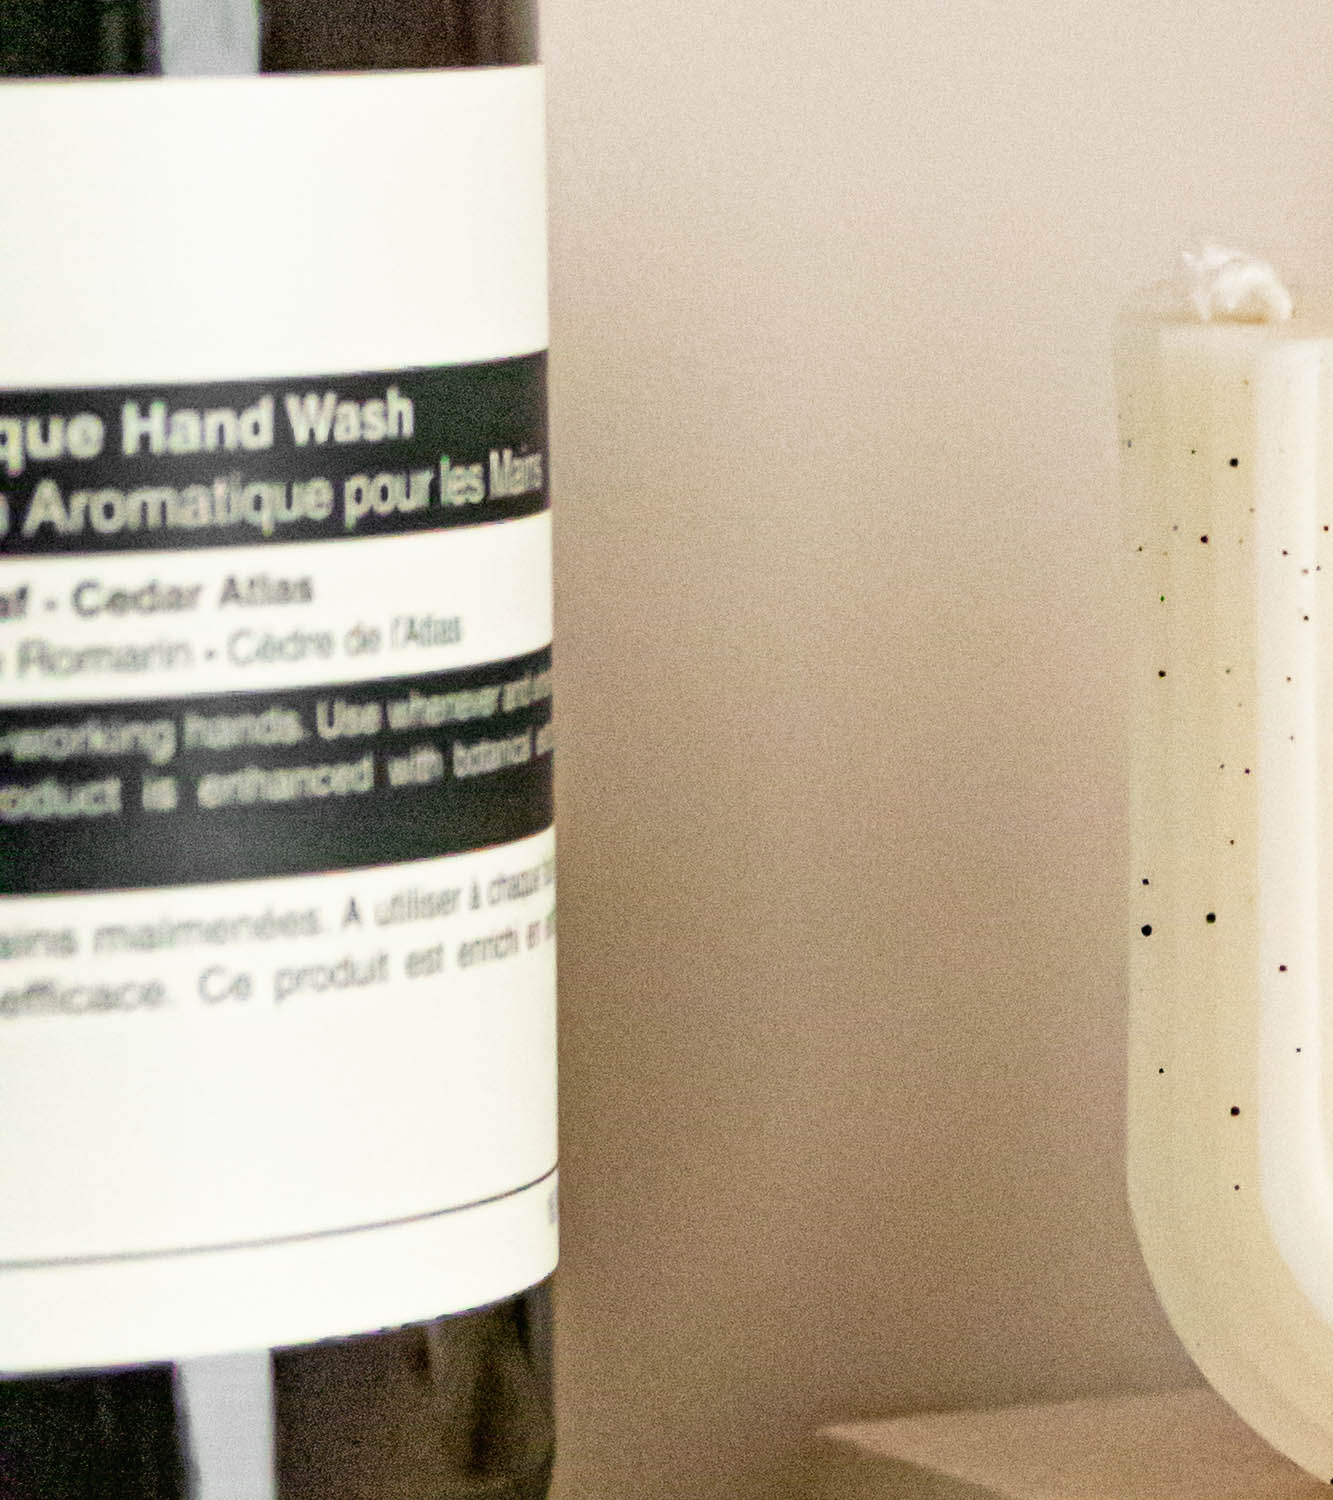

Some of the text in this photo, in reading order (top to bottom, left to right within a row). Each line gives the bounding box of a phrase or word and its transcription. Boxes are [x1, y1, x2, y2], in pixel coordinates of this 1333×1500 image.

[122, 393, 275, 457] Hand
[286, 384, 415, 446] Wash
[23, 472, 334, 537] Aromatique
[344, 467, 434, 532] pour
[440, 455, 485, 506] les
[71, 578, 202, 618] Cedar
[218, 572, 313, 609] Atlas
[315, 699, 382, 741] Use
[142, 773, 177, 812] is
[197, 754, 374, 809] enhanced
[197, 963, 255, 1006] Ce
[272, 951, 390, 1006] produit
